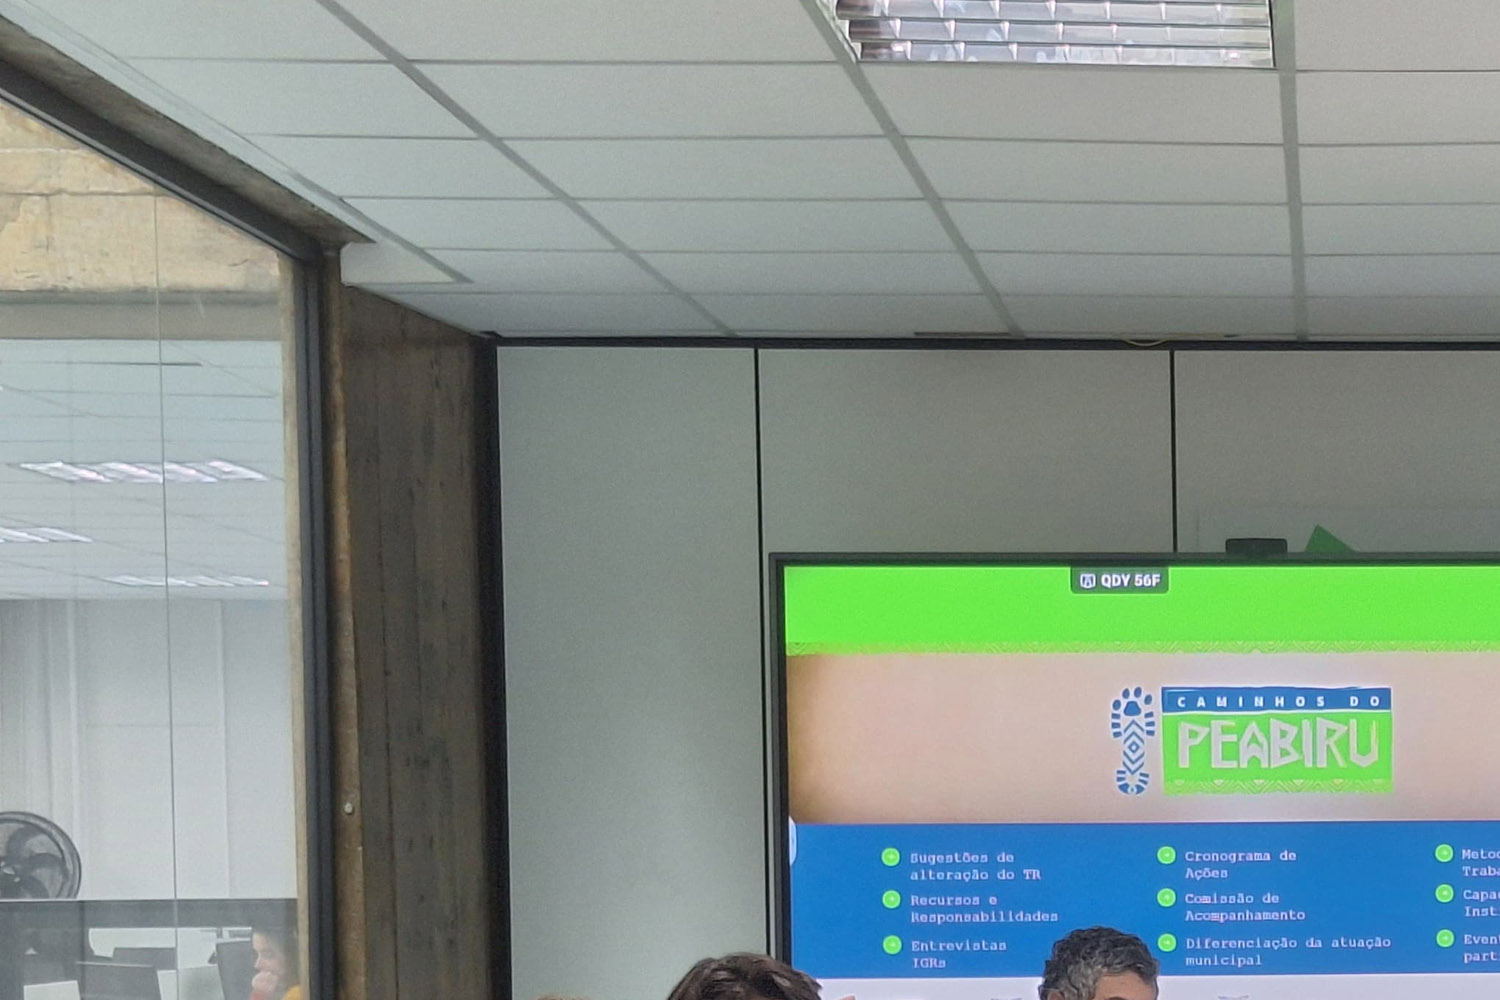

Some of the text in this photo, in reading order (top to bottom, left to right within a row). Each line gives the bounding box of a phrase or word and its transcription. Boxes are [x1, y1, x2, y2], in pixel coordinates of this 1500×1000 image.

[1101, 574, 1161, 588] QDY 56F
[1177, 696, 1380, 708] CAMINHOS DO
[1178, 717, 1379, 769] PEABIRU
[910, 852, 988, 866] Sugestões
[1185, 850, 1297, 864] Cronograma de
[910, 869, 1042, 882] alteração do TR
[1185, 867, 1228, 880] Ações
[910, 895, 998, 906] Recursos e
[1185, 892, 1280, 904] Comissão de
[911, 911, 1059, 925] Responsabilidades
[1185, 909, 1306, 923] Acompanhamento
[911, 940, 1007, 952] Entrevistas
[1186, 937, 1391, 951] Diferenciação da atuação
[1185, 954, 1263, 968] municipal
